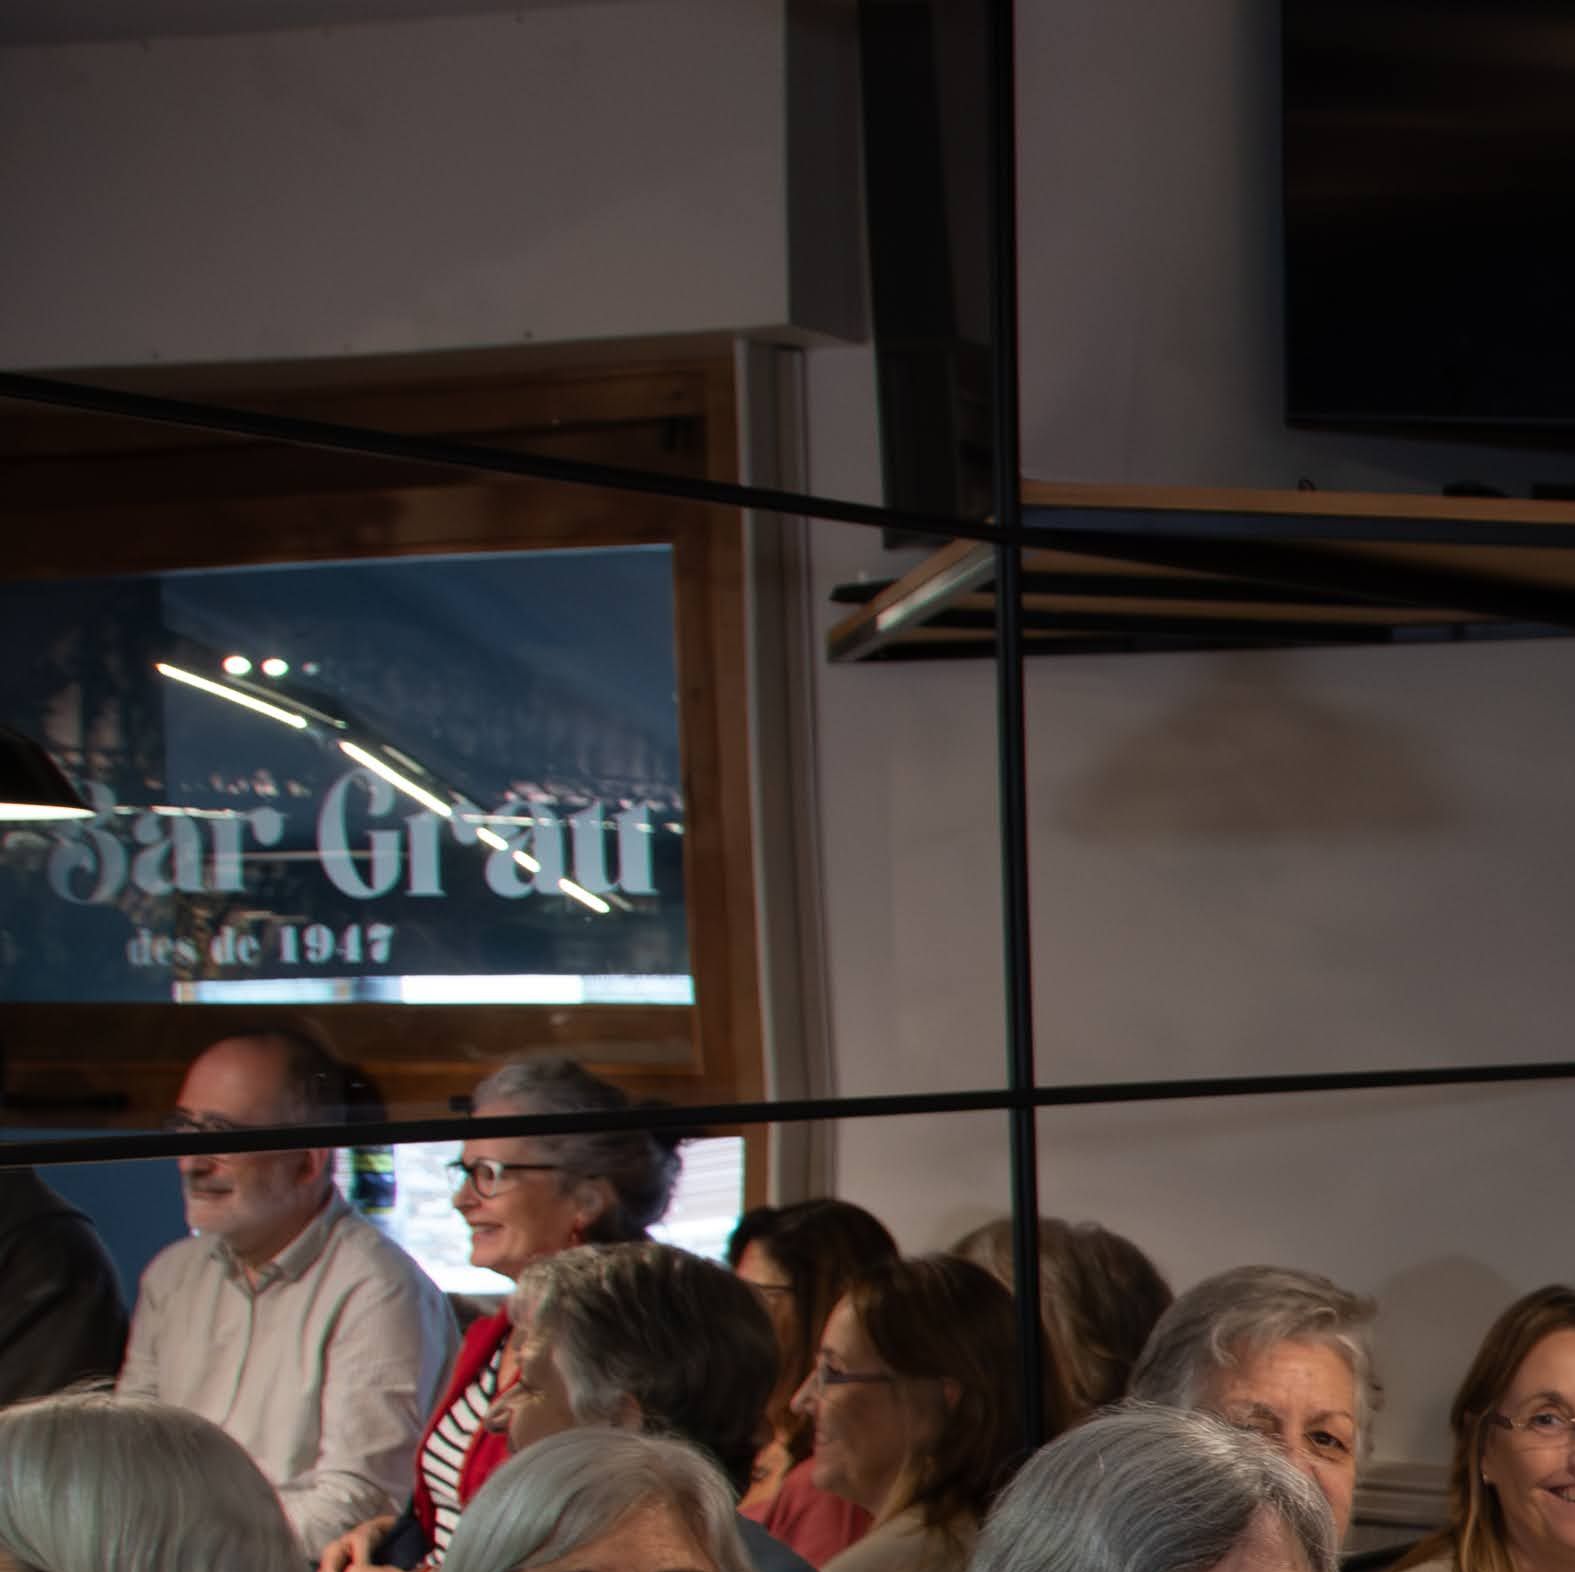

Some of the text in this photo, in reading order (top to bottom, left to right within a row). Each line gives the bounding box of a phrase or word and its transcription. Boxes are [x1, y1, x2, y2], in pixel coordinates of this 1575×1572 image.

[317, 771, 658, 898] Grau
[127, 923, 395, 966] des de 1947
